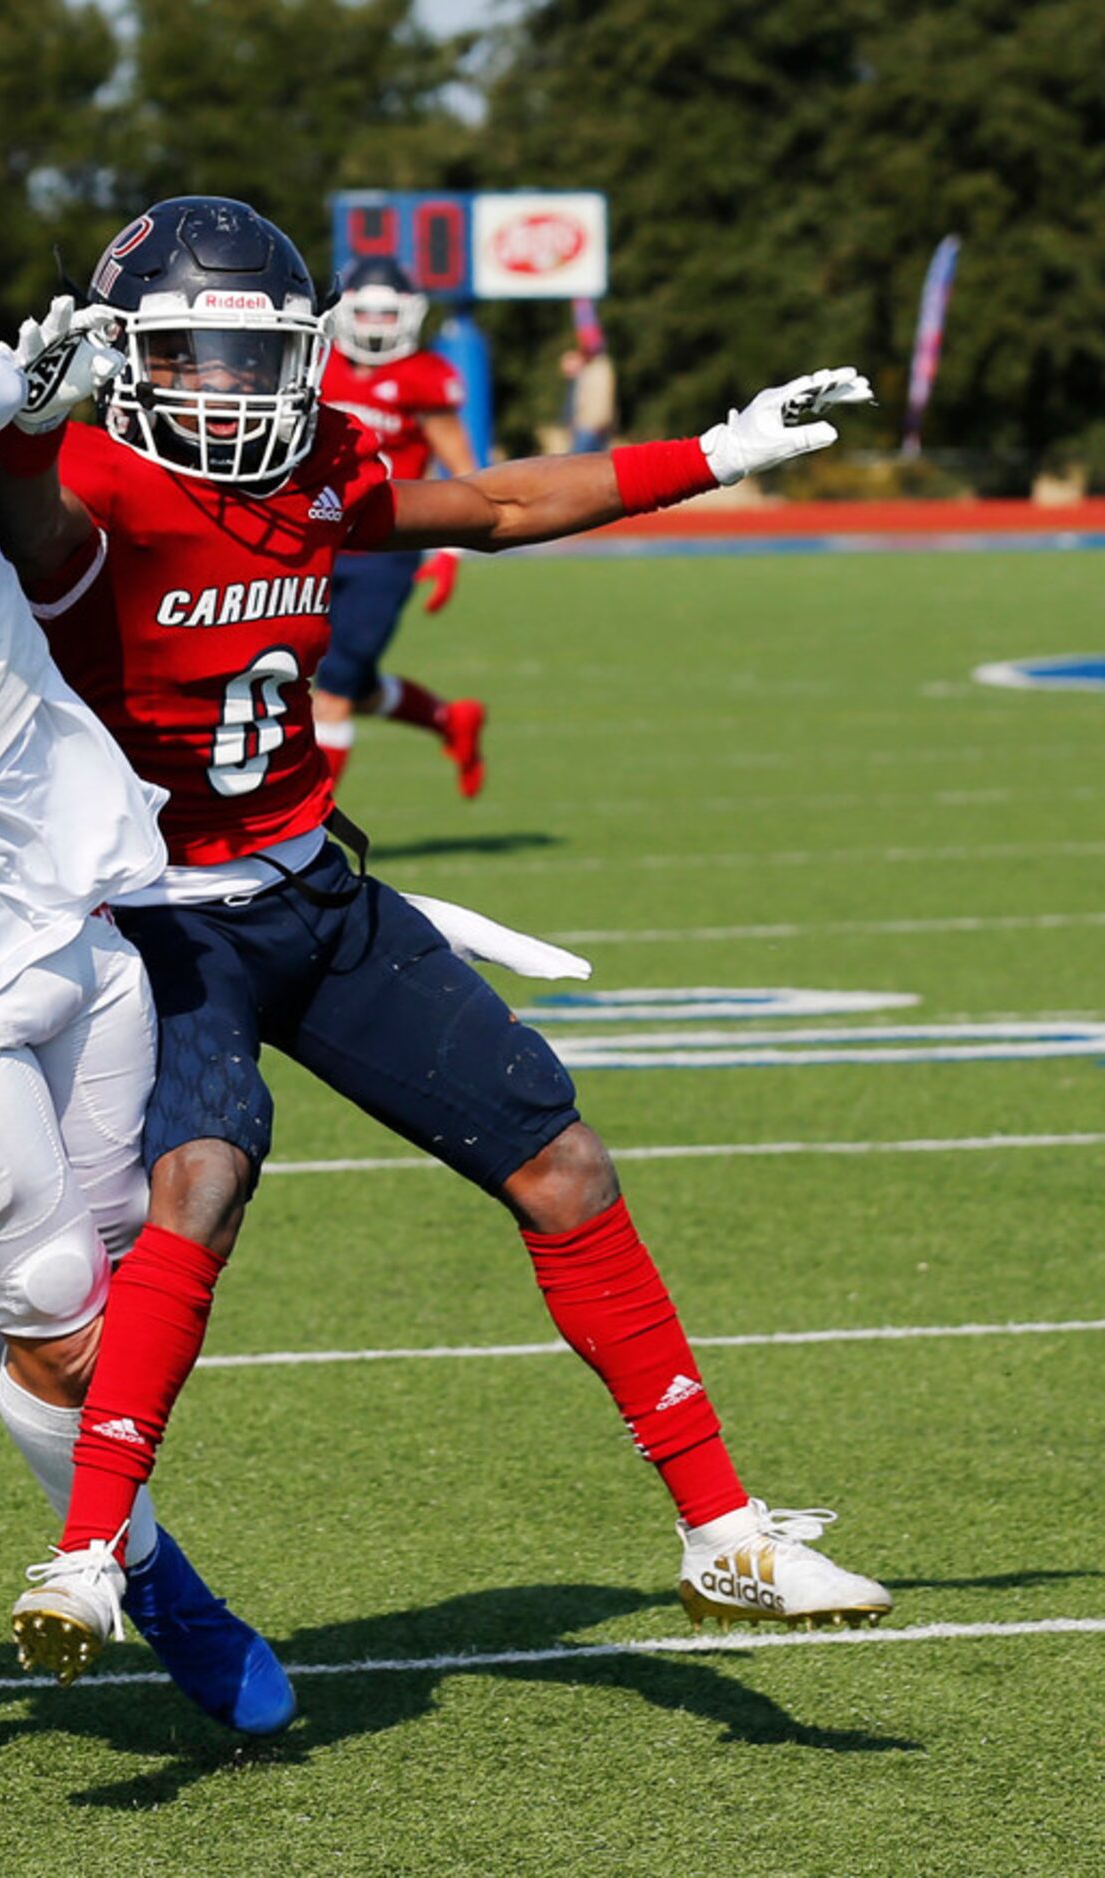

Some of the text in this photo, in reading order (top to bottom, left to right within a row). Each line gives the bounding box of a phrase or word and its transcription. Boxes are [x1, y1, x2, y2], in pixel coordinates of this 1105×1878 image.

[205, 293, 267, 310] Riddell
[307, 507, 343, 522] adida
[155, 577, 331, 627] CARDINAL
[700, 1570, 786, 1613] adidas
